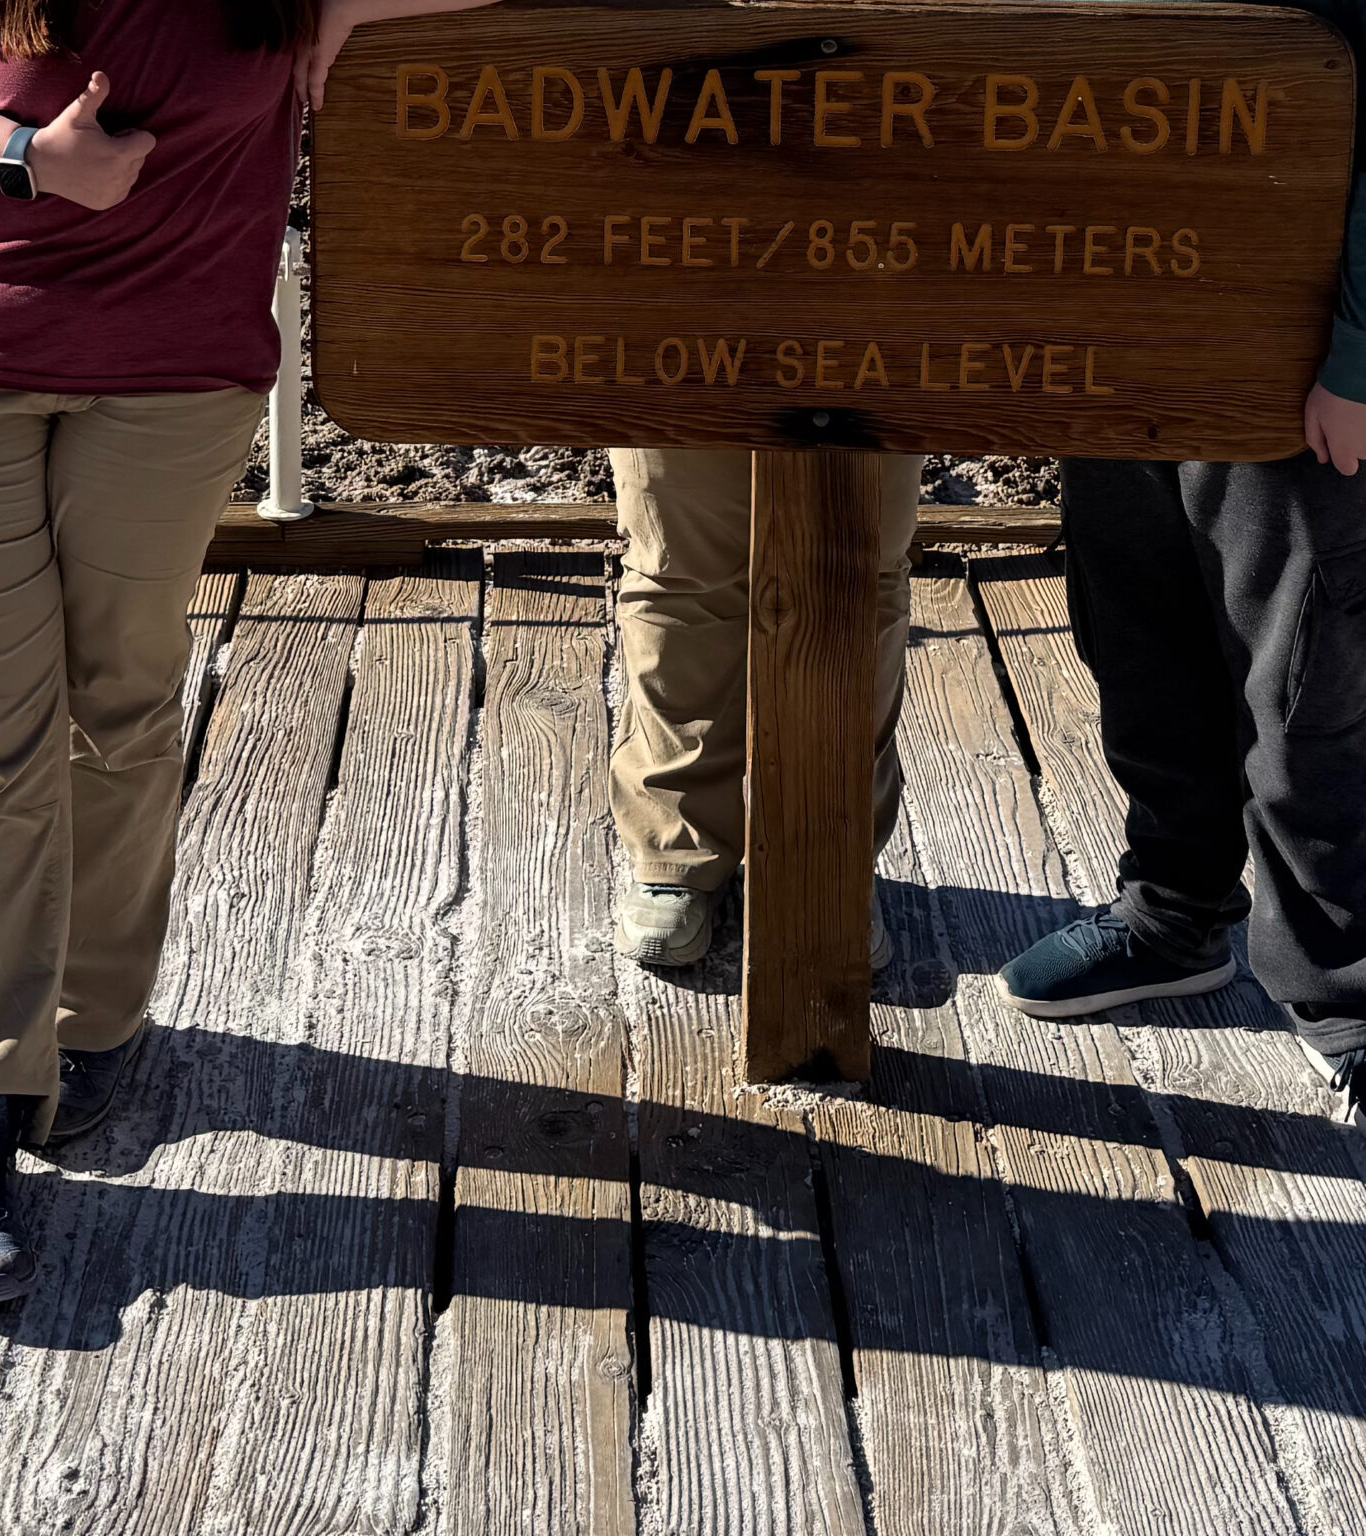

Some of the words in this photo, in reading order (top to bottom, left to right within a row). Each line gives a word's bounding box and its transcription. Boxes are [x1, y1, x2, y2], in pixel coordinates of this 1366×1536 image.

[395, 64, 935, 148] BADWATER
[983, 73, 1269, 156] BASIN
[460, 214, 569, 263] 282
[949, 222, 1201, 277] METERS
[530, 335, 748, 387] BELOW
[776, 339, 890, 389] SEA
[919, 342, 1115, 395] LEVEL
